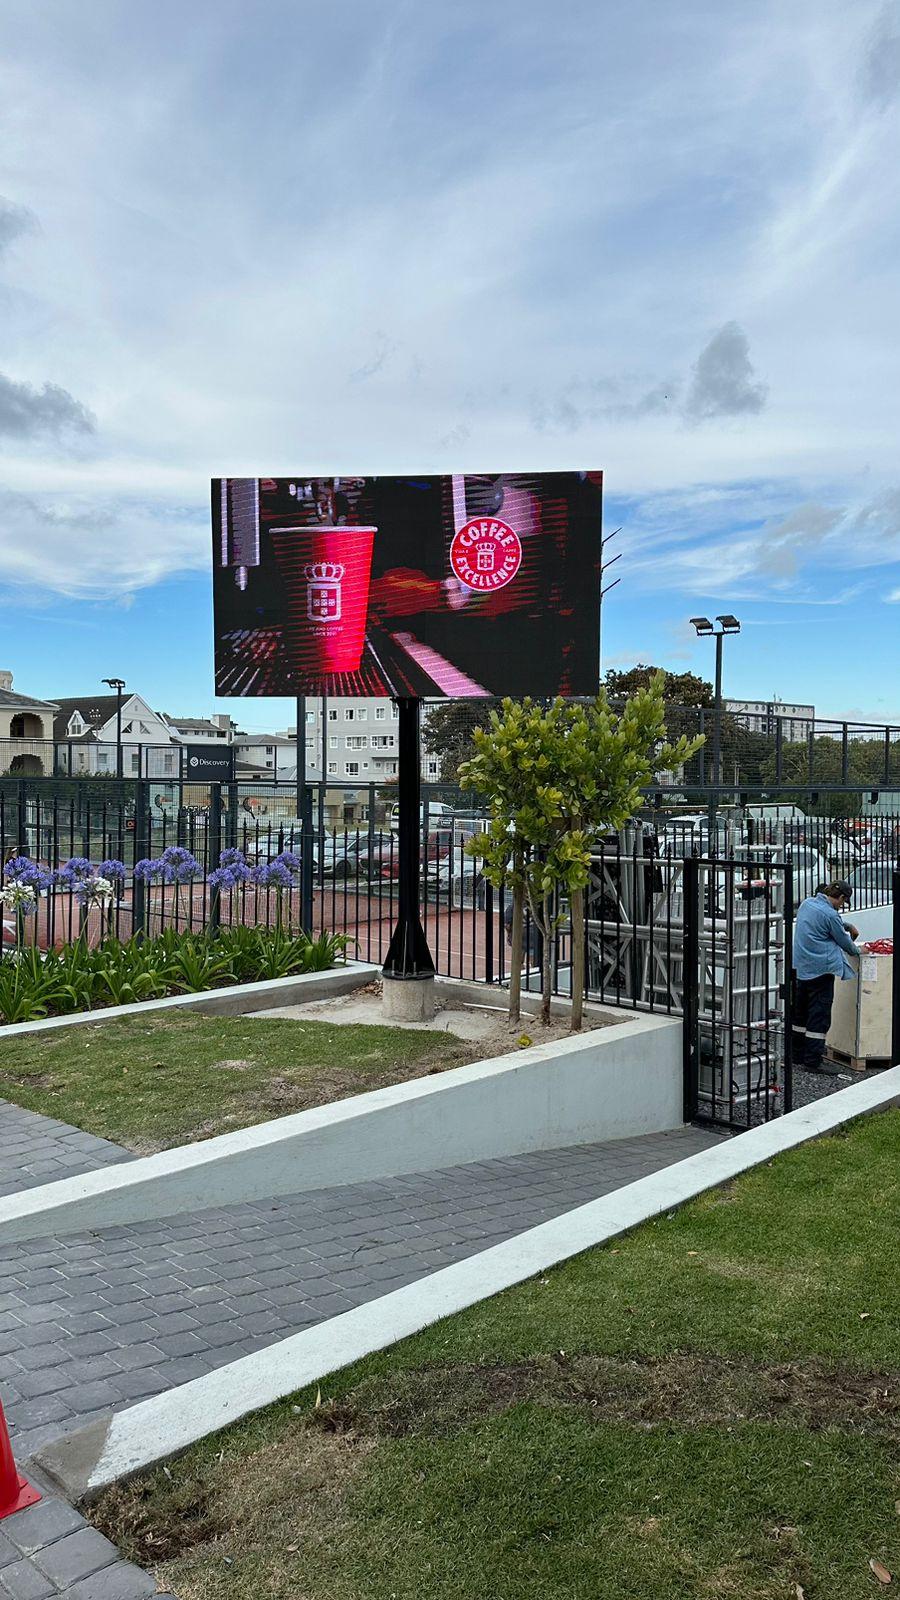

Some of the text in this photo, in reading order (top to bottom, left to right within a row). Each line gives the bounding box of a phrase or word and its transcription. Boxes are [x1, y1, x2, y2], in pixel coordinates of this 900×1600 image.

[460, 522, 515, 547] COFFEE
[456, 555, 517, 587] EXCELLENCE
[199, 758, 230, 767] Discovery
